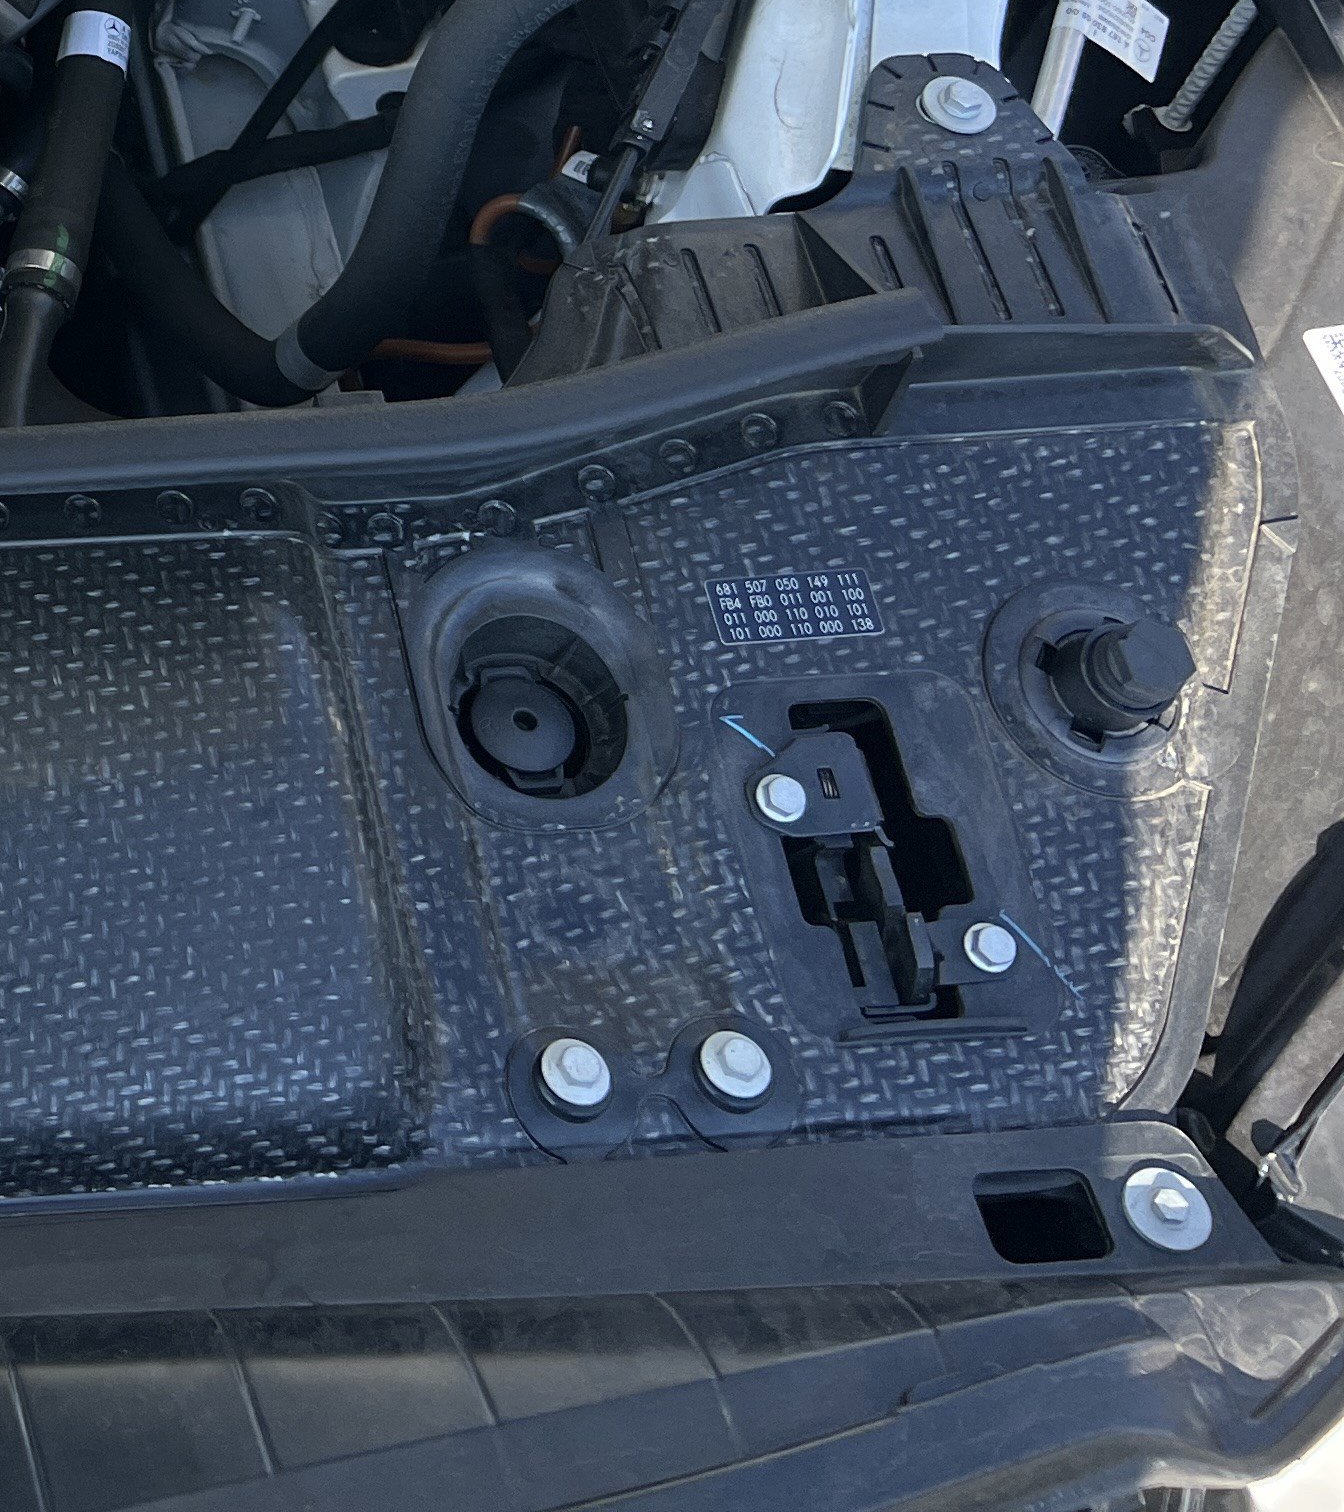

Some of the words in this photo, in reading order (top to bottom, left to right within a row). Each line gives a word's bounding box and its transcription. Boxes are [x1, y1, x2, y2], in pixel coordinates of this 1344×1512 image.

[716, 582, 737, 595] 681
[745, 579, 767, 594] 507
[775, 578, 798, 591] 050
[807, 575, 828, 588] 149
[837, 573, 859, 586] 111
[719, 598, 742, 610] FB4
[780, 593, 802, 605] 011
[810, 590, 833, 603] 001
[842, 588, 864, 601] 100
[724, 612, 746, 625] 011
[754, 610, 778, 623] 000
[786, 607, 808, 621] 110
[815, 605, 839, 618] 010
[847, 603, 869, 616] 101
[729, 628, 751, 640] 101
[758, 625, 782, 638] 000
[790, 623, 813, 635] 110
[819, 620, 843, 633] 000
[851, 617, 874, 631] 138
